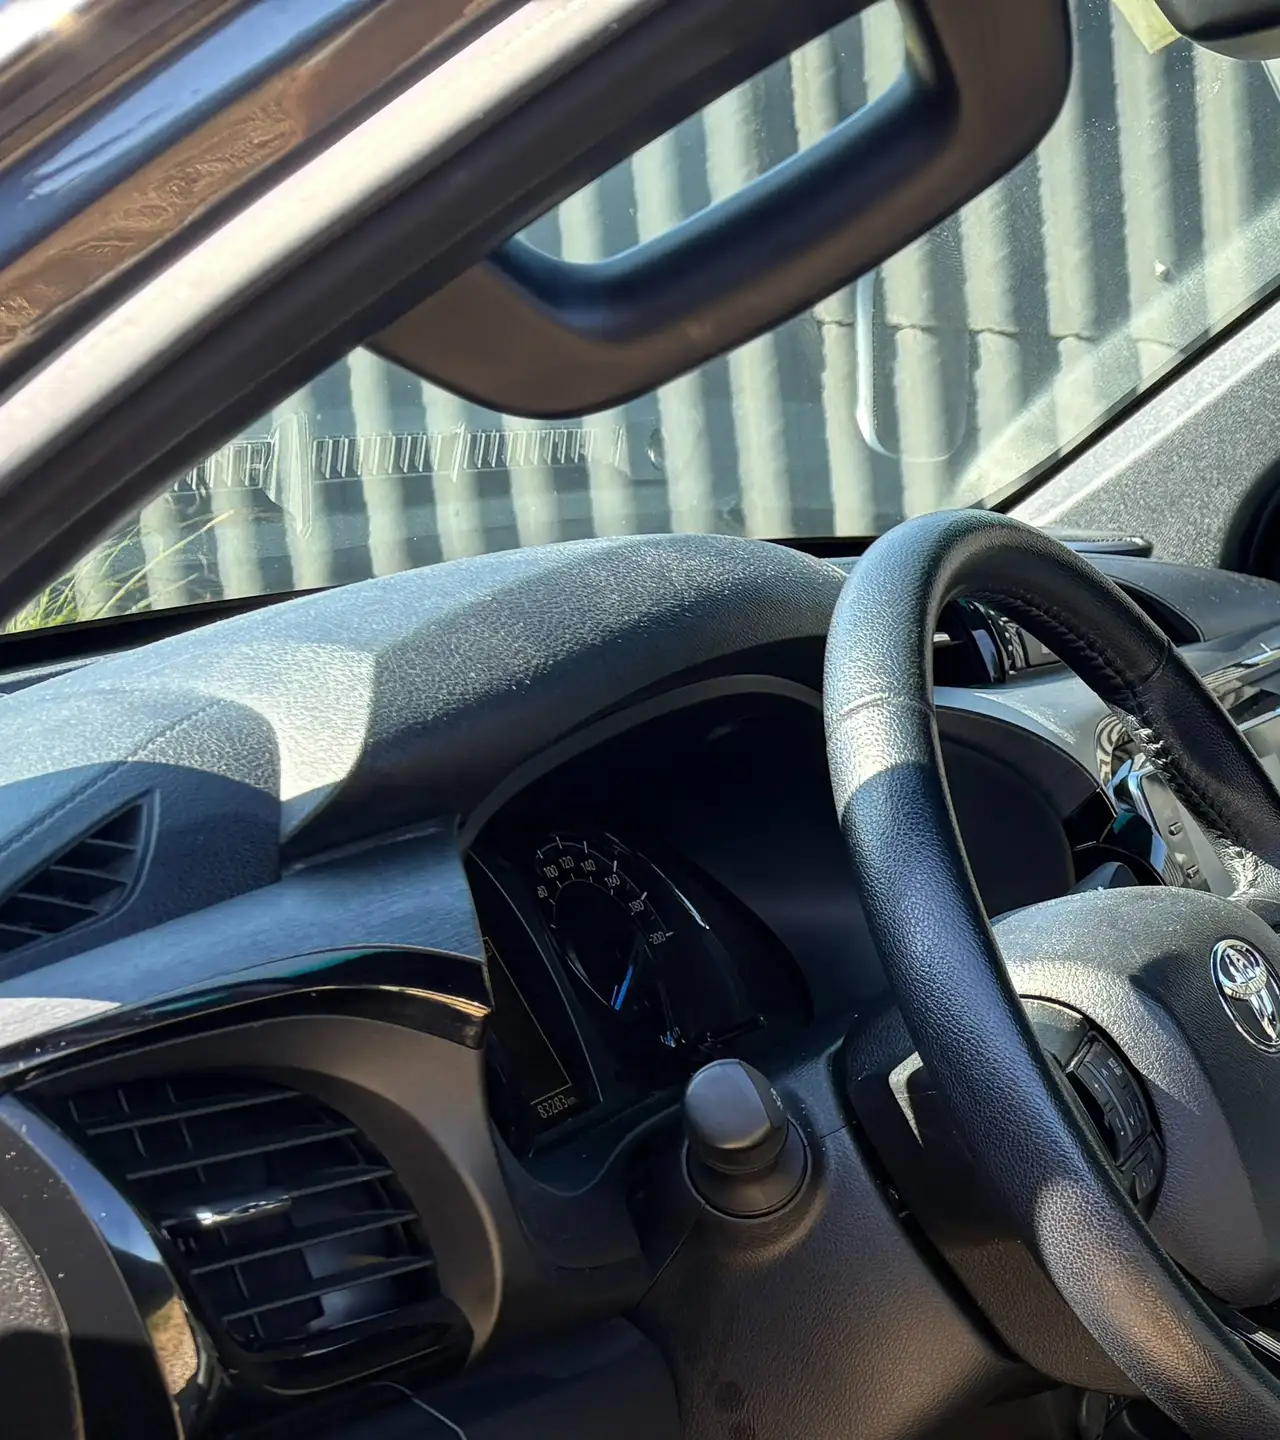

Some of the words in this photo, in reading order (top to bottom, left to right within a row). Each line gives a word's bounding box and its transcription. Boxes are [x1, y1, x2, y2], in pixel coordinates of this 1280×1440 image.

[558, 855, 575, 869] 120
[580, 859, 597, 873] 140
[543, 864, 559, 878] 100
[604, 873, 621, 888] 160
[536, 885, 549, 899] 80
[628, 899, 645, 913] 180
[651, 931, 667, 945] 200
[536, 1094, 569, 1119] 83283
